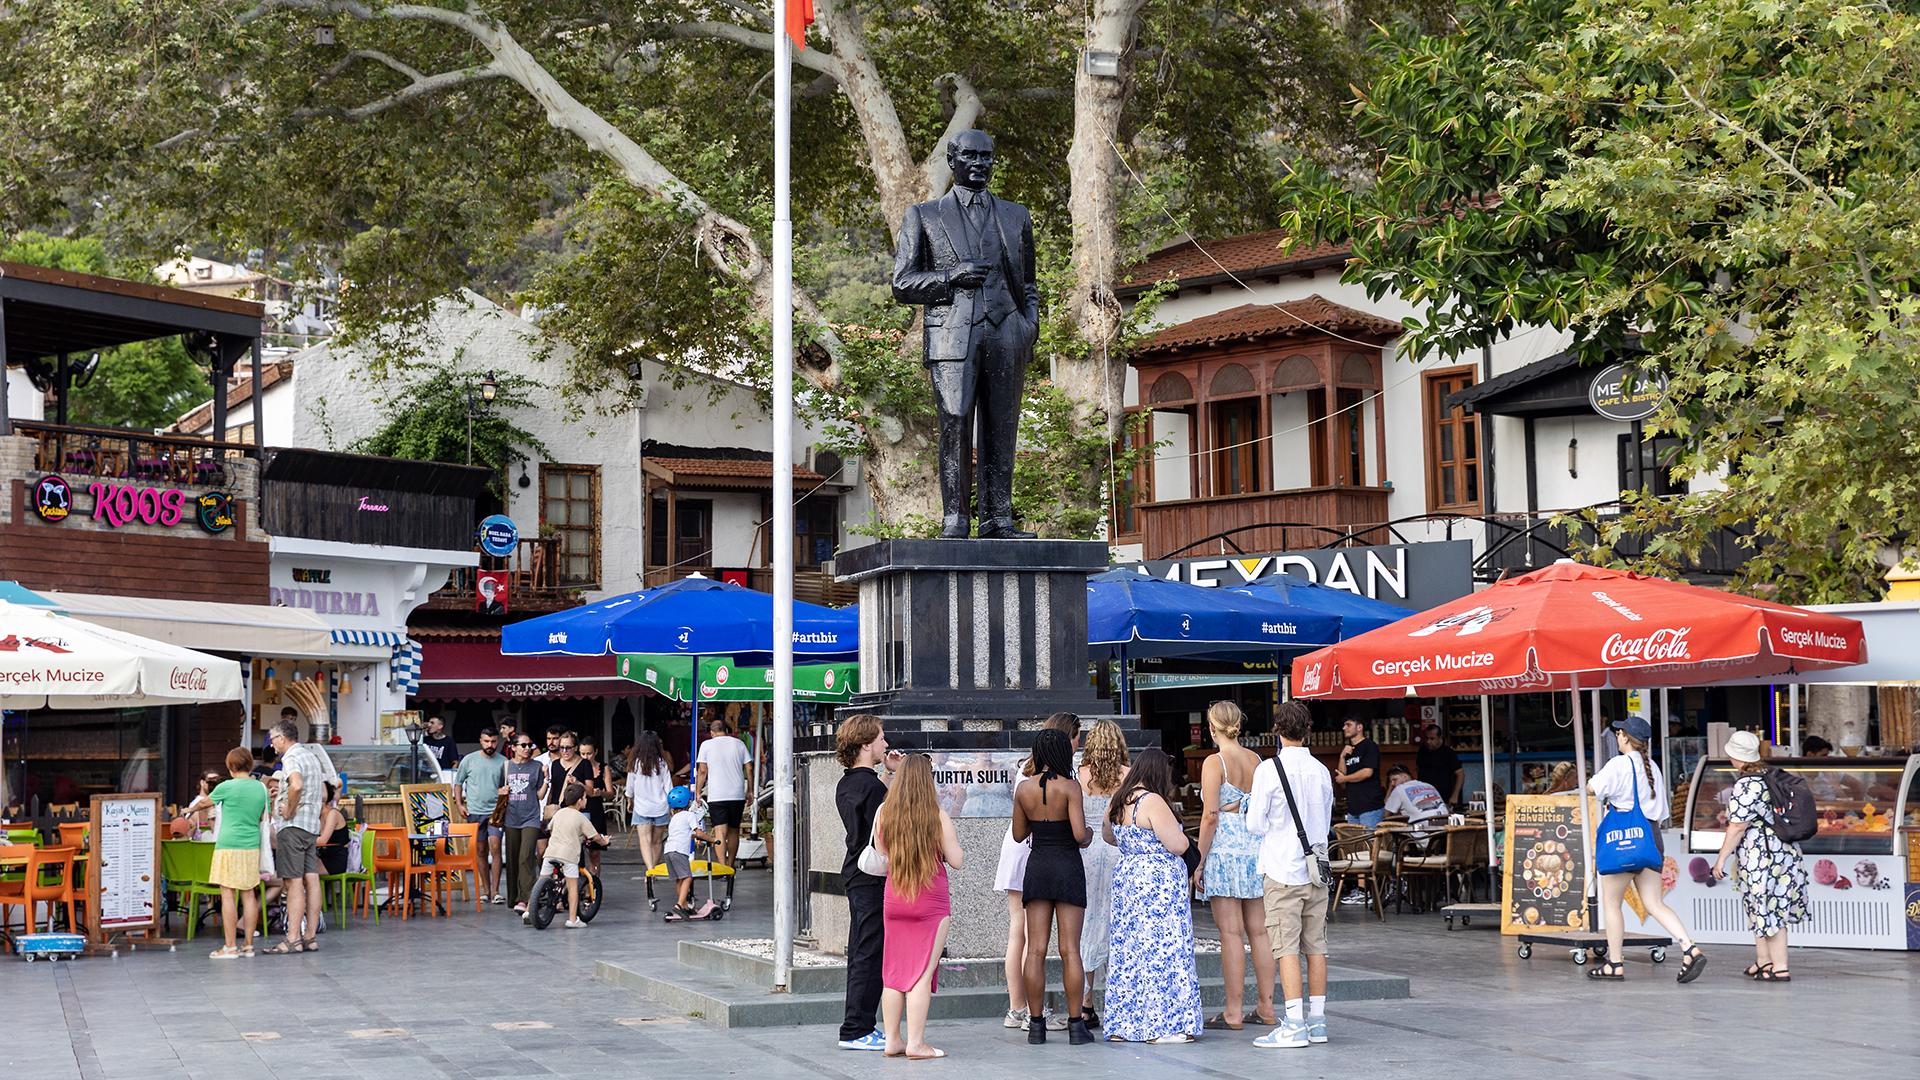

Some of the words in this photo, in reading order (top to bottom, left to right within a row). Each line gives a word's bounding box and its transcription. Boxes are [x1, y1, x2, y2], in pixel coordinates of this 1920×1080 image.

[1597, 380, 1662, 397] MEDAN
[1598, 397, 1620, 406] CAFE
[1622, 395, 1630, 404] &
[1632, 392, 1662, 403] BISTRO
[89, 482, 185, 527] KOOS
[358, 496, 389, 512] Terrace
[292, 568, 331, 584] WAFFLE
[270, 587, 379, 616] ONDURMA
[1601, 627, 1691, 664] Coca-Cola
[1780, 627, 1813, 648] Gerçek
[1814, 633, 1848, 649] Mucize
[1372, 659, 1431, 677] Gerçek
[1435, 651, 1495, 670] Mucize
[0, 669, 41, 686] erçek
[46, 669, 104, 683] Mucize
[977, 770, 1012, 785] SULH,
[1515, 805, 1556, 813] Pancake
[1515, 813, 1565, 823] Kahvaltısı
[1606, 830, 1624, 844] KIND
[1625, 827, 1644, 840] MIND
